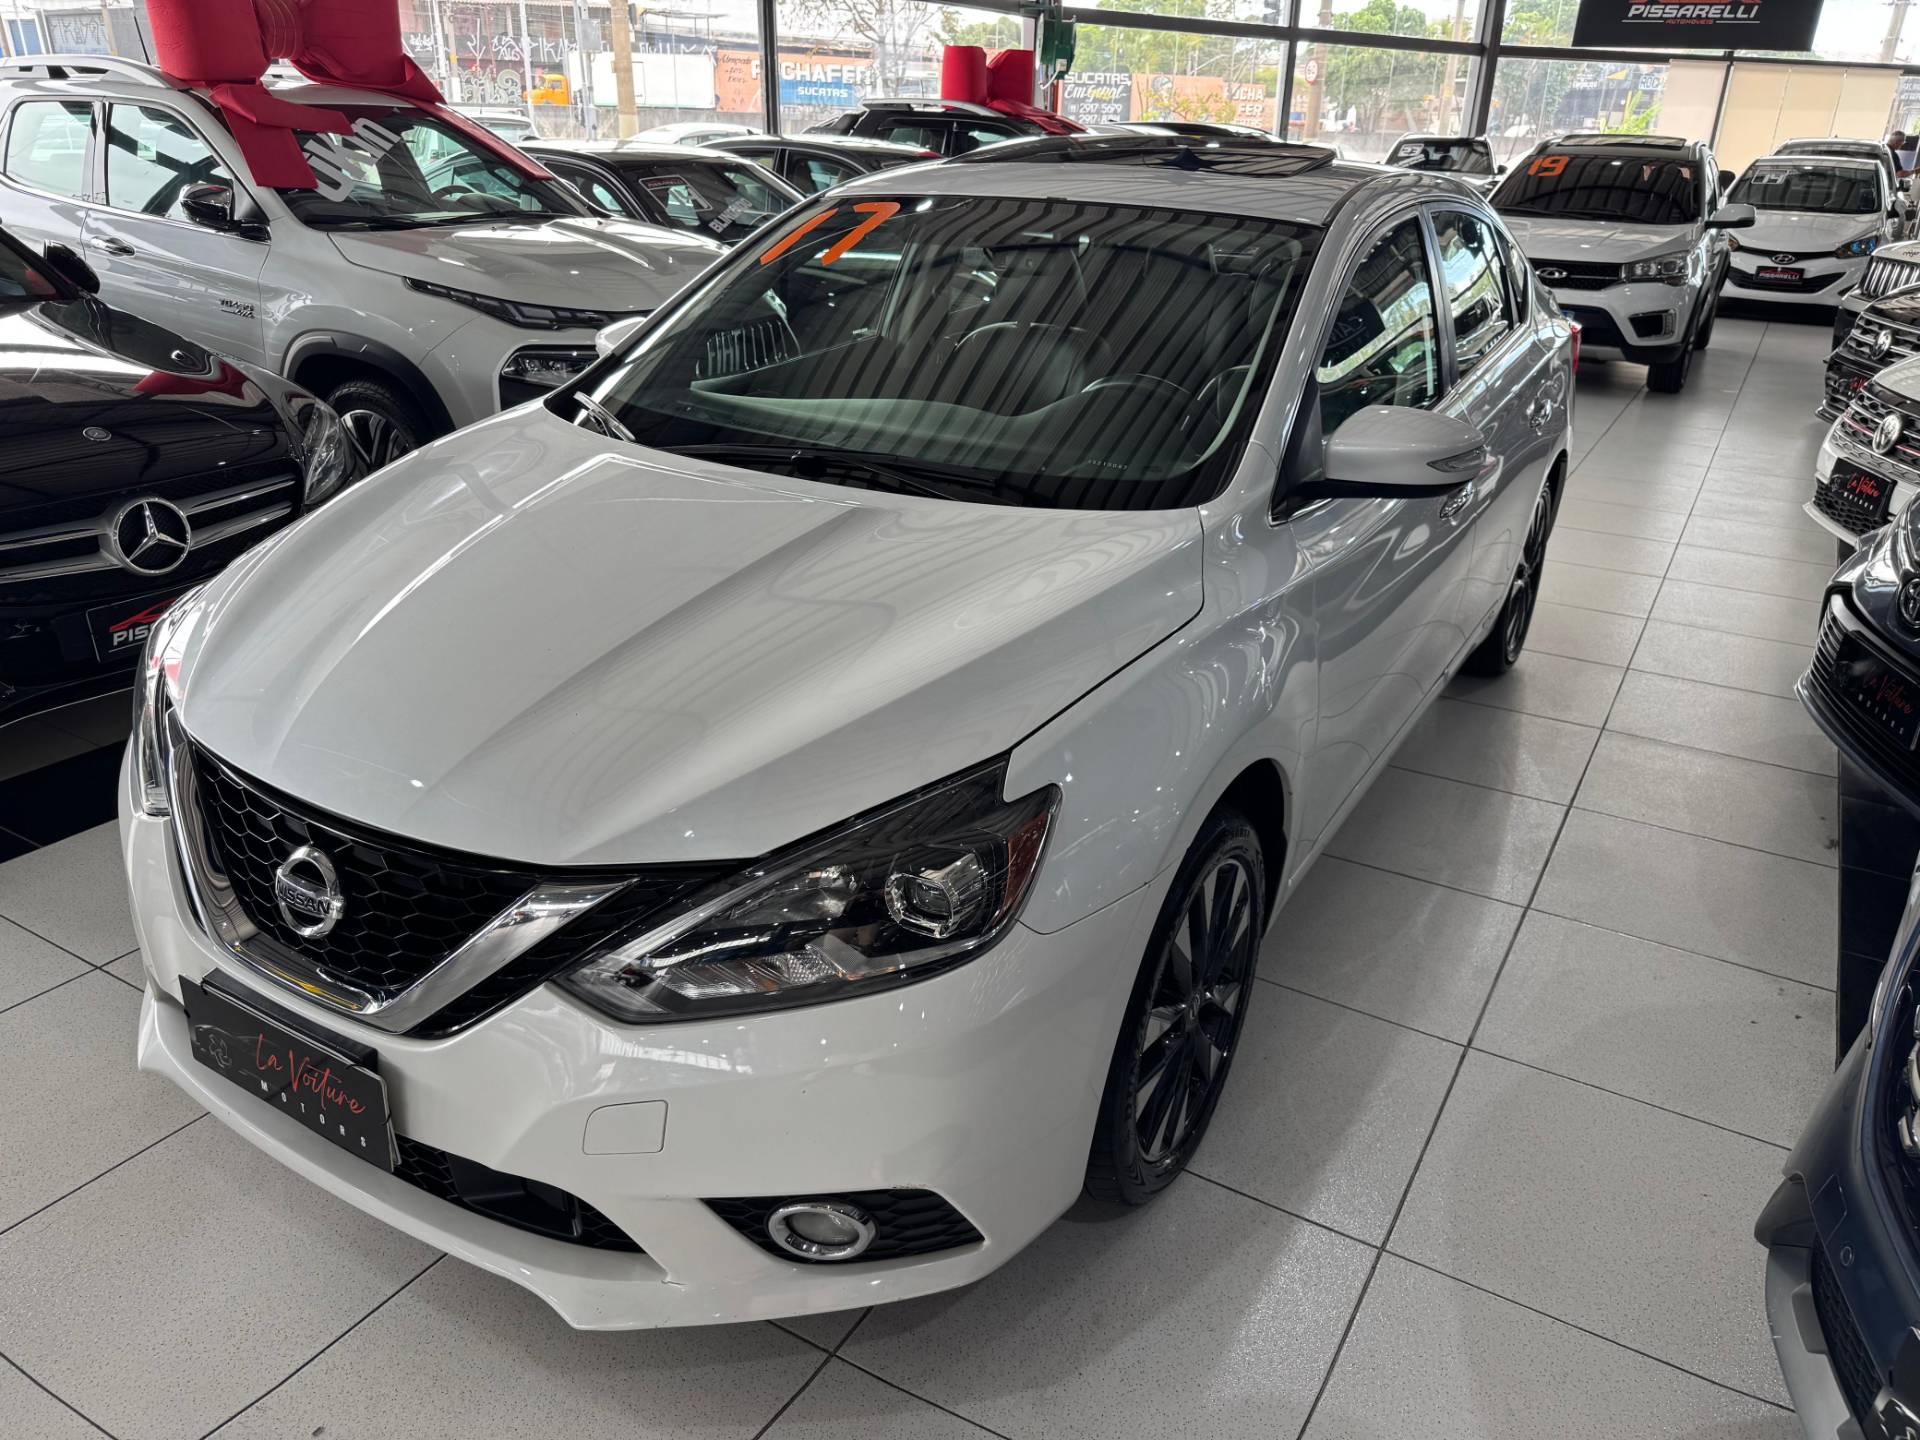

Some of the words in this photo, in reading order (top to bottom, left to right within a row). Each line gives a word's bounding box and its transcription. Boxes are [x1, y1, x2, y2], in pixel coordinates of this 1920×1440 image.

[1627, 4, 1760, 19] PISSARELLI
[1064, 71, 1131, 86] SUCATAS
[799, 86, 849, 98] SUCATAS
[1527, 155, 1570, 177] 19
[759, 201, 901, 267] 17
[278, 878, 331, 916] NISSAN
[255, 1033, 284, 1072] La
[288, 1049, 367, 1115] Voiture
